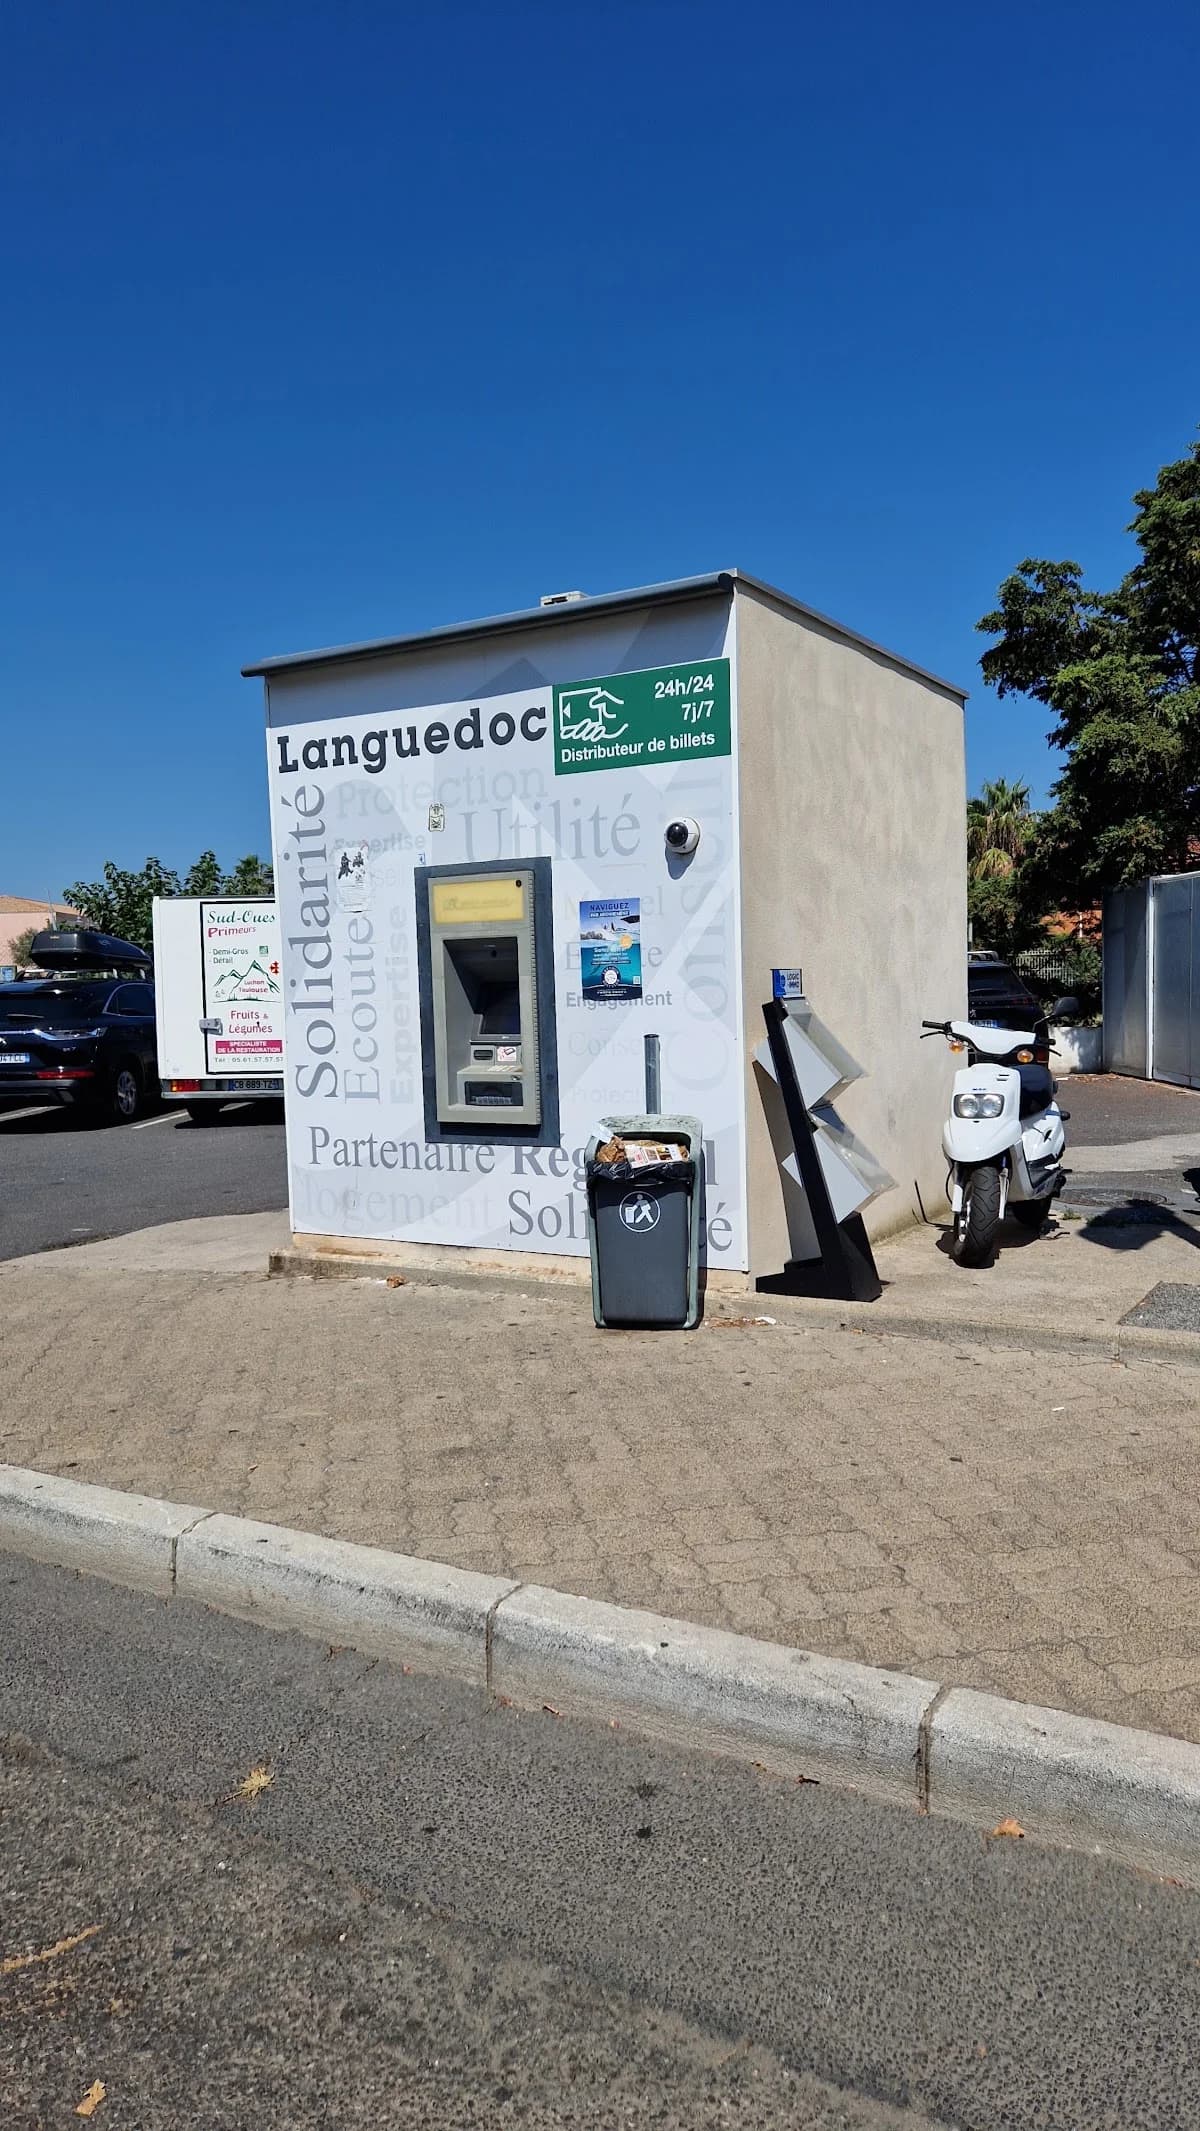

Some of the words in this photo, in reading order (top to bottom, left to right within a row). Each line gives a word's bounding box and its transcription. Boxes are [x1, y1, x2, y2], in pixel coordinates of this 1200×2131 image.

[654, 674, 714, 699] 24h/24
[681, 700, 714, 723] 7j/7
[277, 706, 548, 774] Languedoc
[561, 742, 644, 763] Distributeur
[648, 738, 666, 752] de
[670, 732, 715, 750] billets
[335, 765, 549, 821] Protection
[458, 793, 641, 862] Utilité
[207, 910, 275, 924] Sud-Oues
[590, 902, 630, 911] NAVIGUEZ
[208, 926, 256, 938] Primeurs
[280, 784, 340, 1099] Solidarité
[229, 1024, 273, 1034] Légumes
[231, 1010, 260, 1020] Fruits
[308, 1126, 496, 1174] Partenaire
[511, 1132, 719, 1192] Régl
[508, 1189, 733, 1252] Solié
